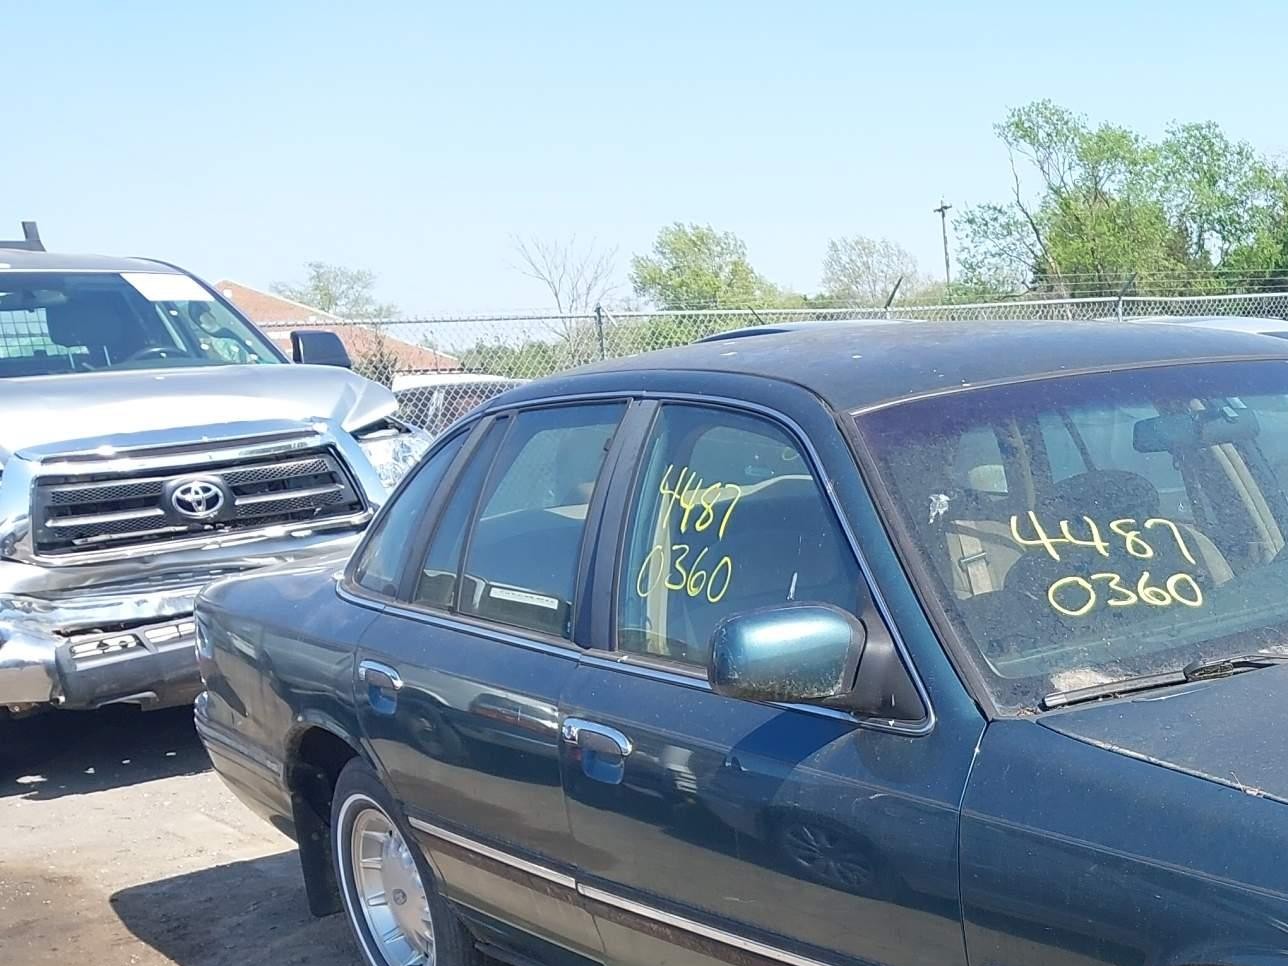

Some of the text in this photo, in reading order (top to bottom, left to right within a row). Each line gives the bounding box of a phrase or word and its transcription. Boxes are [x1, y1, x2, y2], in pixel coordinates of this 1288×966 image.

[659, 463, 742, 541] 4487
[1010, 510, 1196, 566] 4487
[636, 544, 733, 603] 0360
[1048, 571, 1203, 616] 0360
